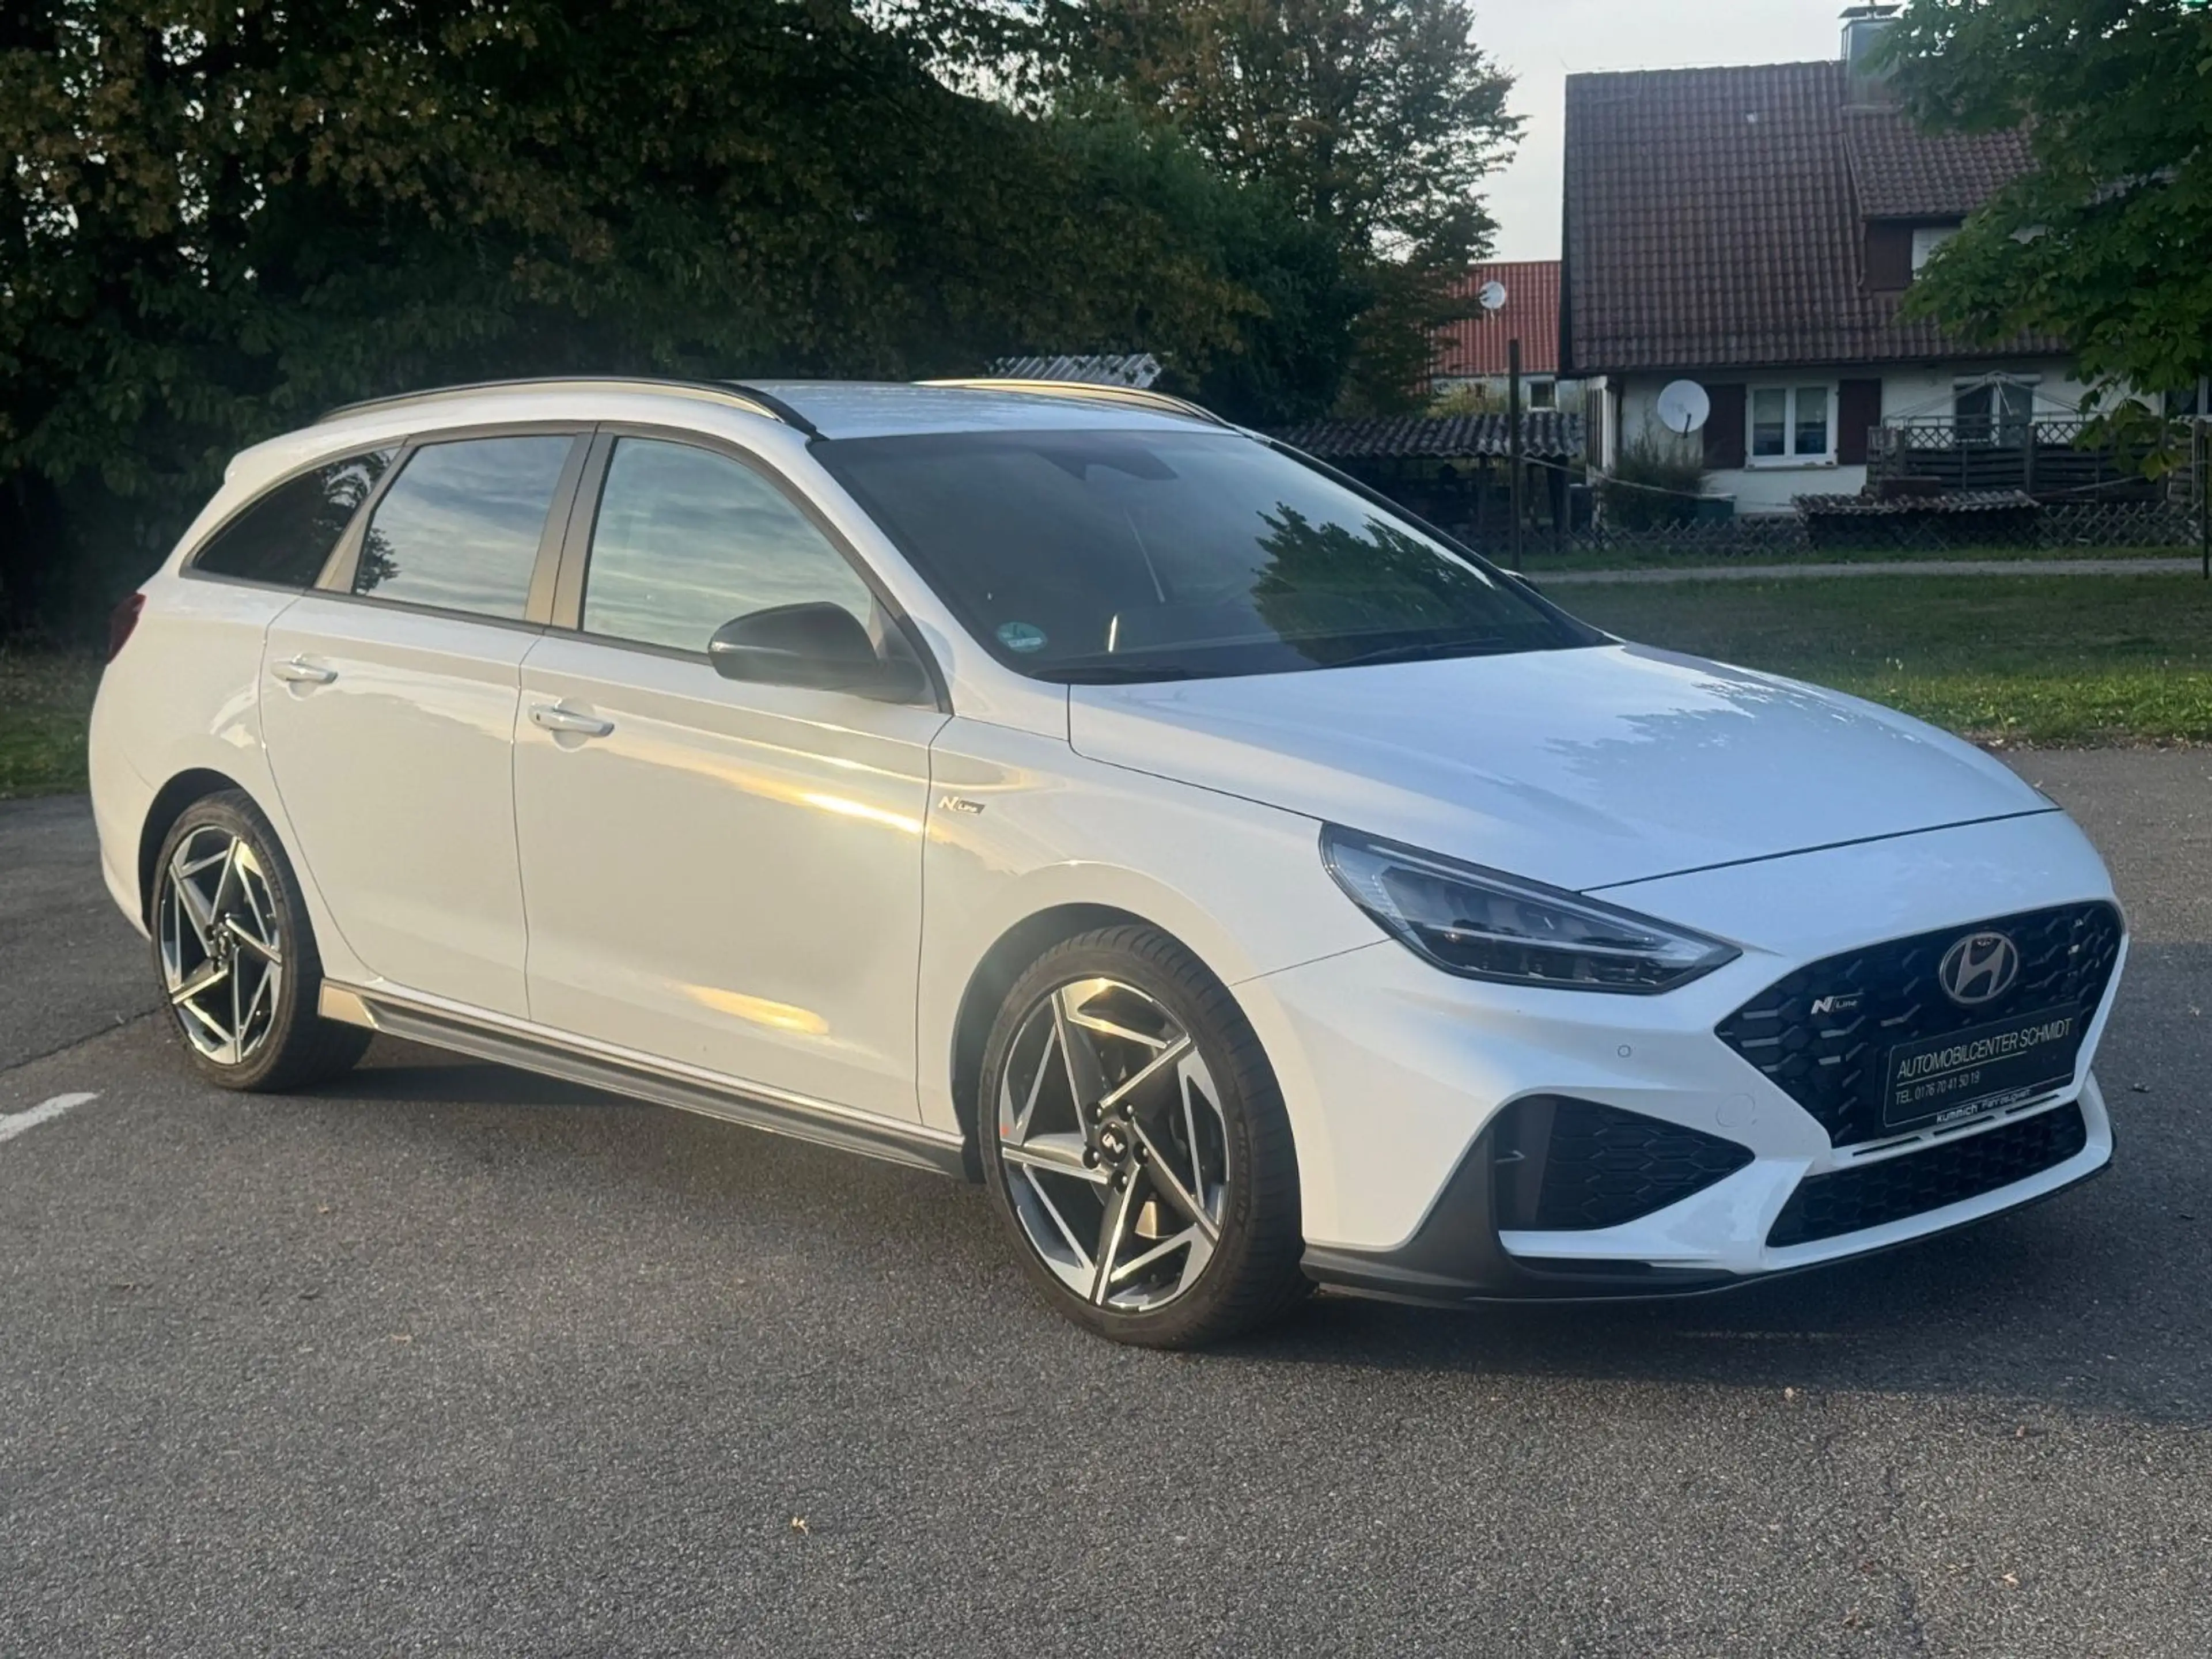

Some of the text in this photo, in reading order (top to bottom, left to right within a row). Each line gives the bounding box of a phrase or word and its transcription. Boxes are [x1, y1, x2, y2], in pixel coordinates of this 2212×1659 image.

[1810, 995, 1834, 1014] N
[1897, 1017, 2073, 1080] AUTOMOBILCENTER SCHMIDT
